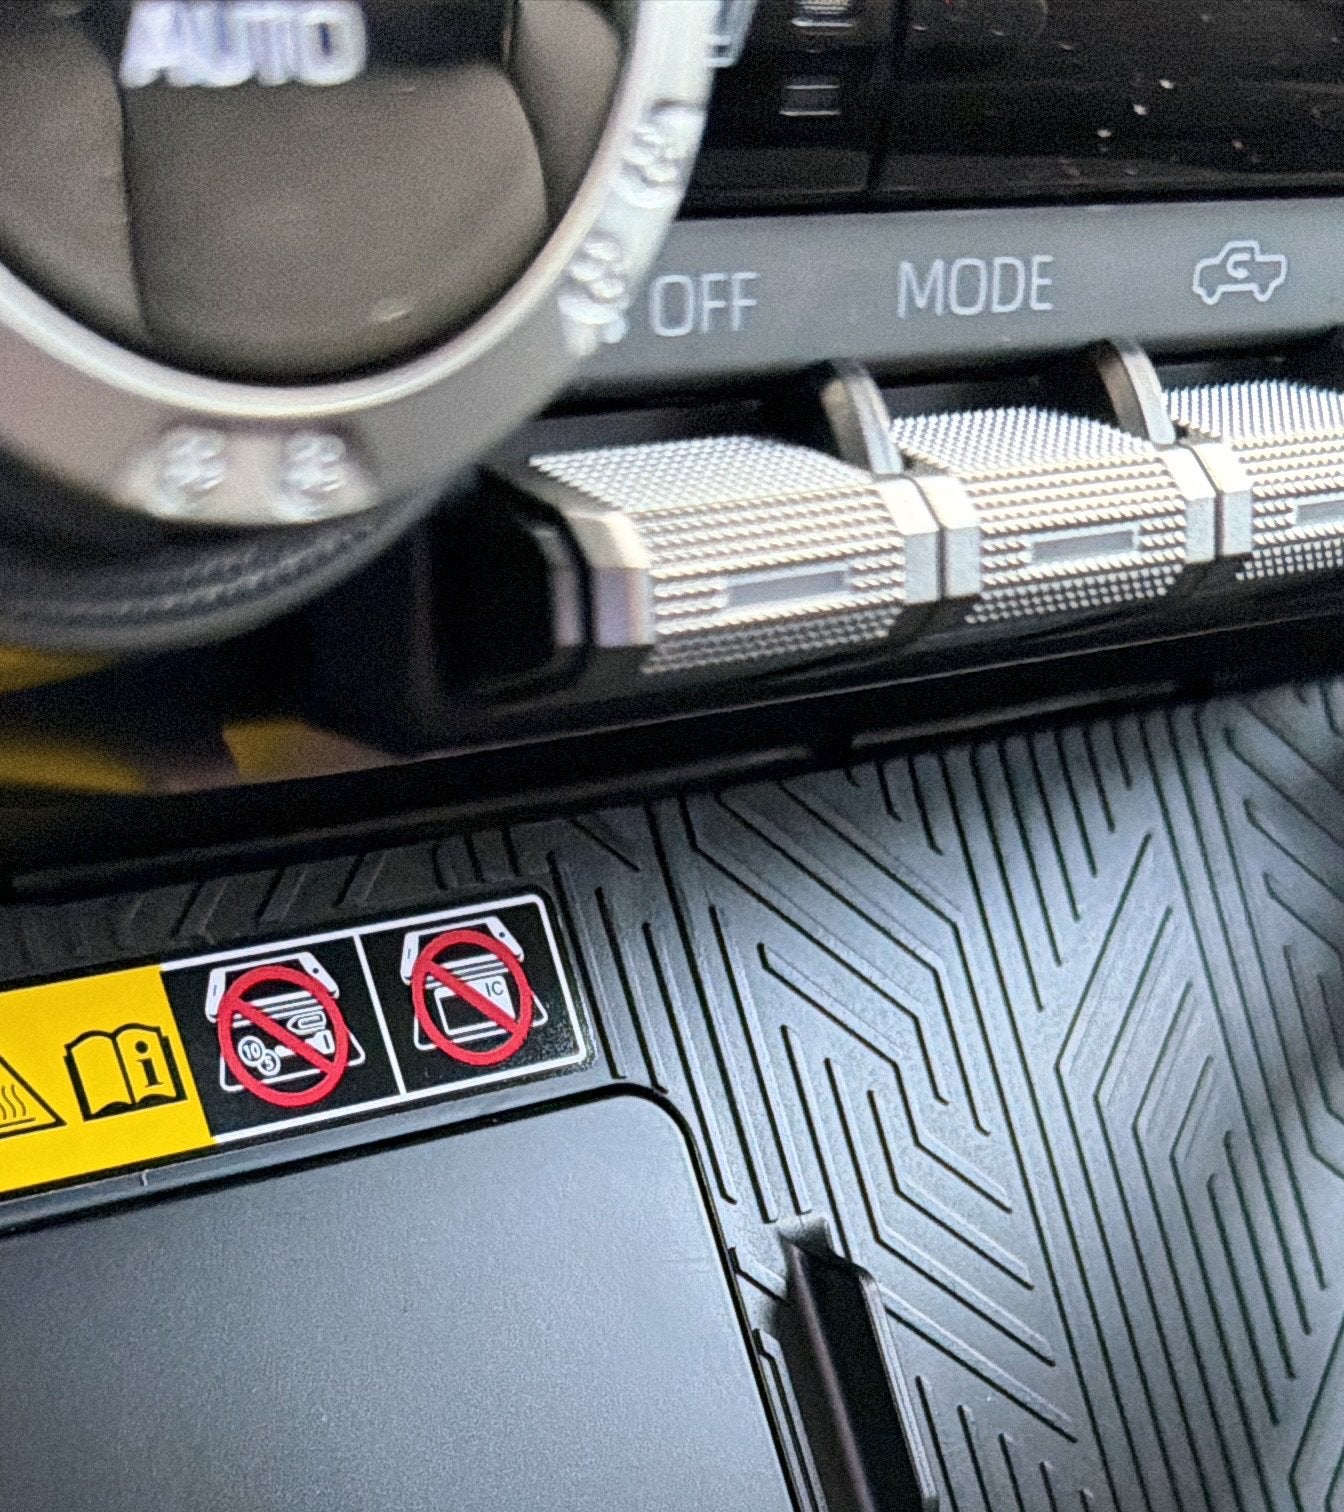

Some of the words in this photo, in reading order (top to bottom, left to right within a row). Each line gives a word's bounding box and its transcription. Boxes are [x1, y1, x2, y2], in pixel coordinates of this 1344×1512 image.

[119, 0, 367, 87] AUTO
[650, 271, 759, 336] OFF
[897, 255, 1054, 318] MODE
[485, 980, 504, 997] IC
